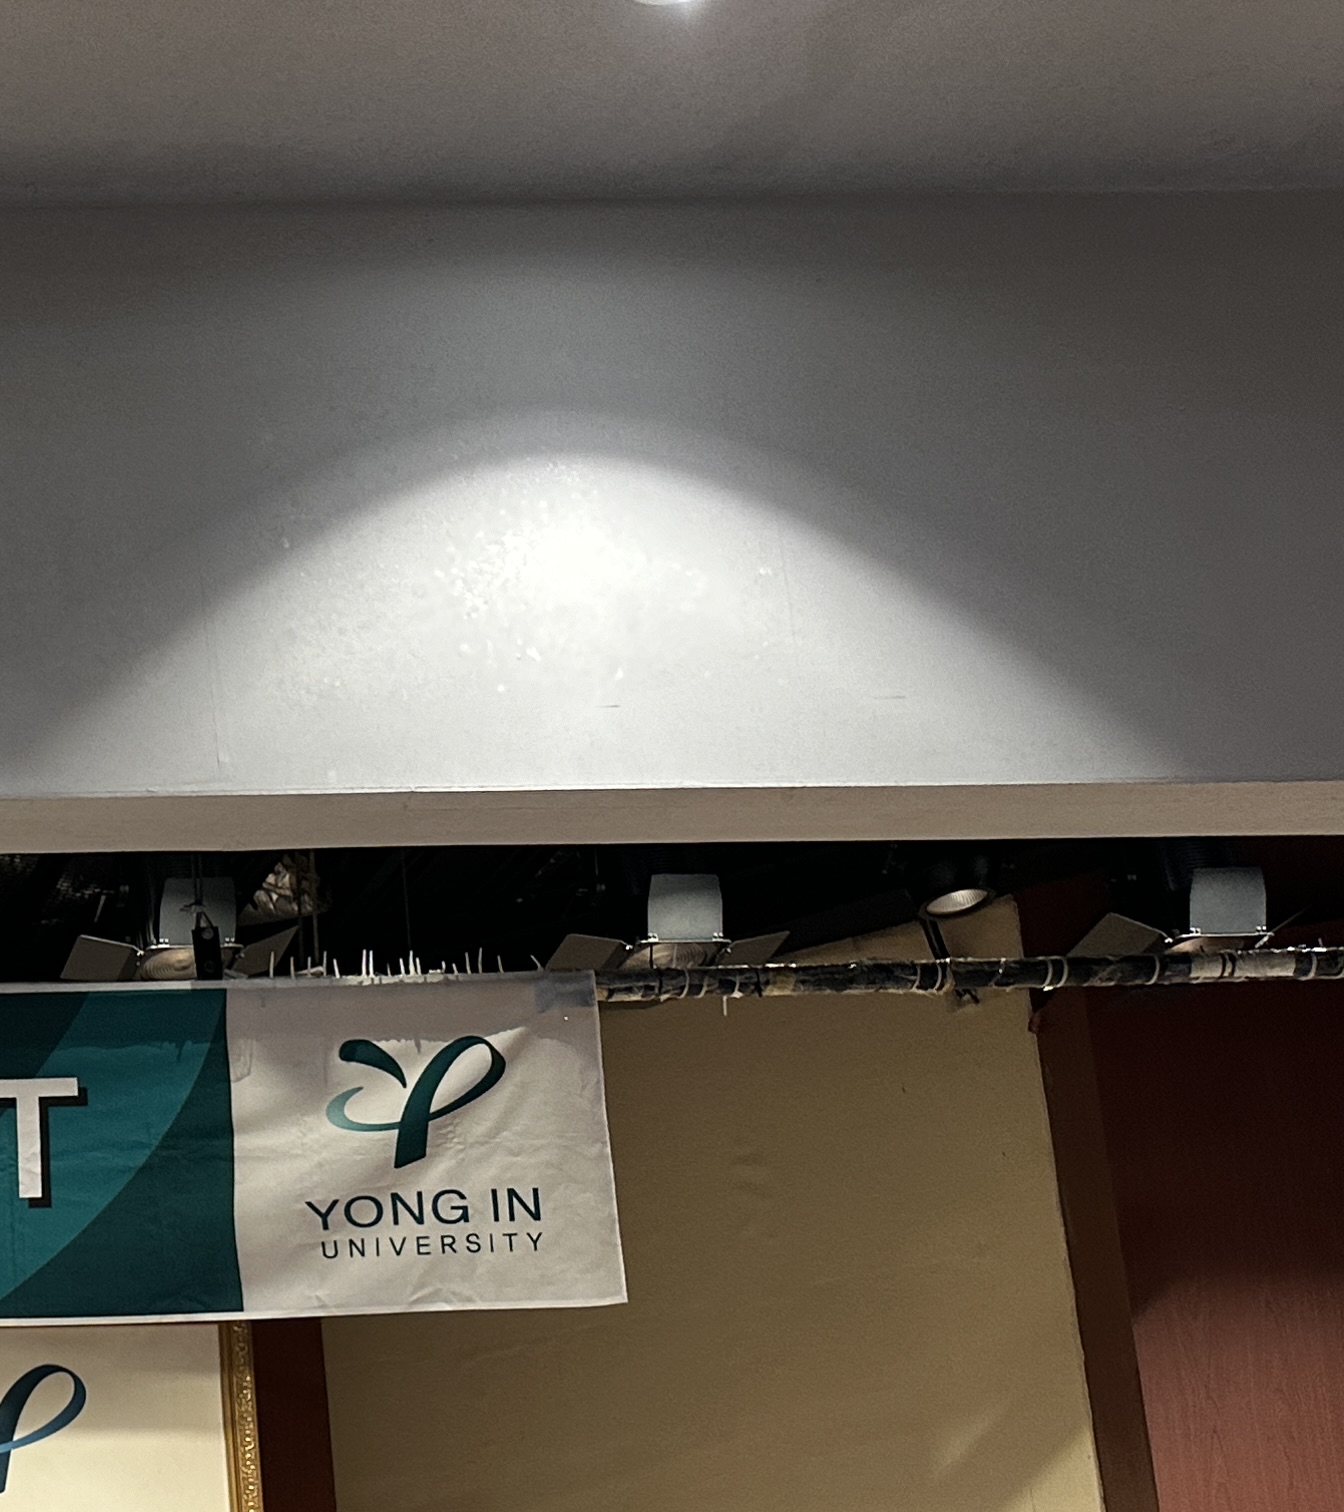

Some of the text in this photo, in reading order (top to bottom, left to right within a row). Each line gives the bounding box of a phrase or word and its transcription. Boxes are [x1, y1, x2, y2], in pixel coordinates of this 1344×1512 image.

[305, 1187, 542, 1231] YONG IN
[320, 1231, 545, 1260] UNIVERSITY
